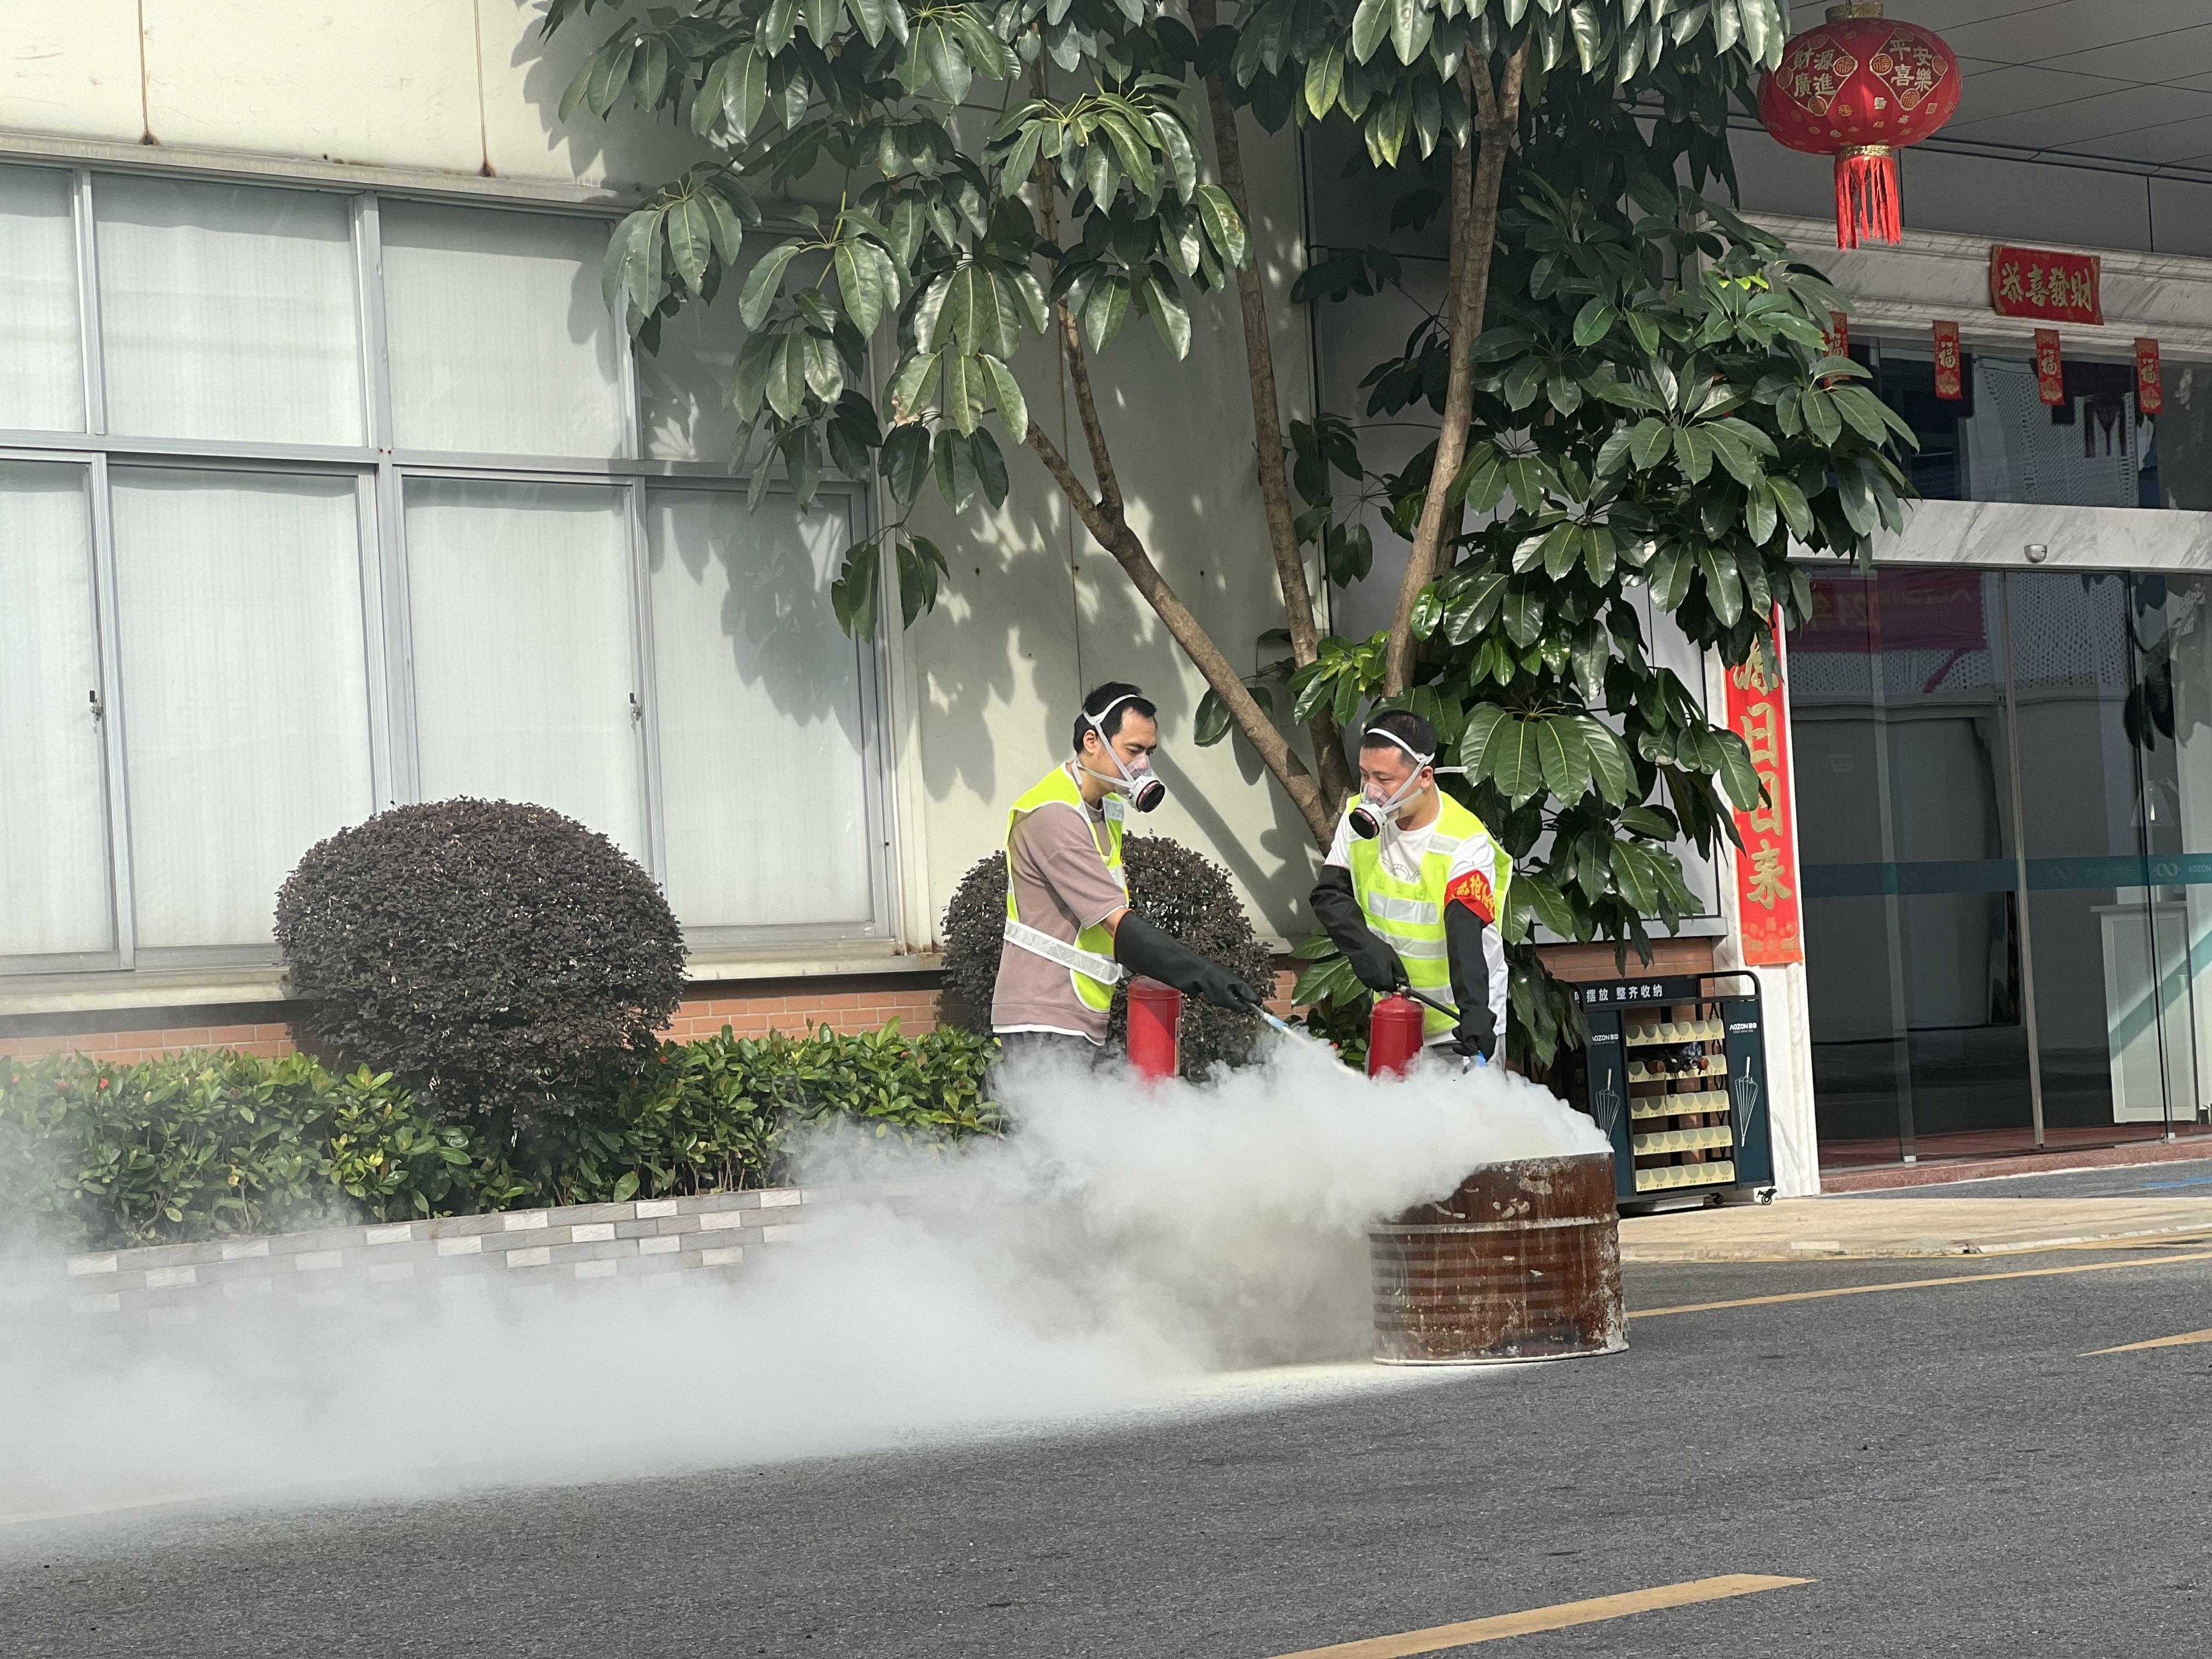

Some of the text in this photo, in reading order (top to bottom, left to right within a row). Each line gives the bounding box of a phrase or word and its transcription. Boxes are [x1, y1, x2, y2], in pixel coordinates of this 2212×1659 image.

[1792, 48, 1835, 71] 財源
[1889, 40, 1933, 66] 平安
[1794, 72, 1836, 97] 廣進
[1891, 63, 1933, 92] 喜樂
[1939, 341, 1956, 368] 福
[2041, 349, 2058, 376] 福
[2141, 358, 2157, 383] 福
[1616, 984, 1662, 1000] 整齐收纳
